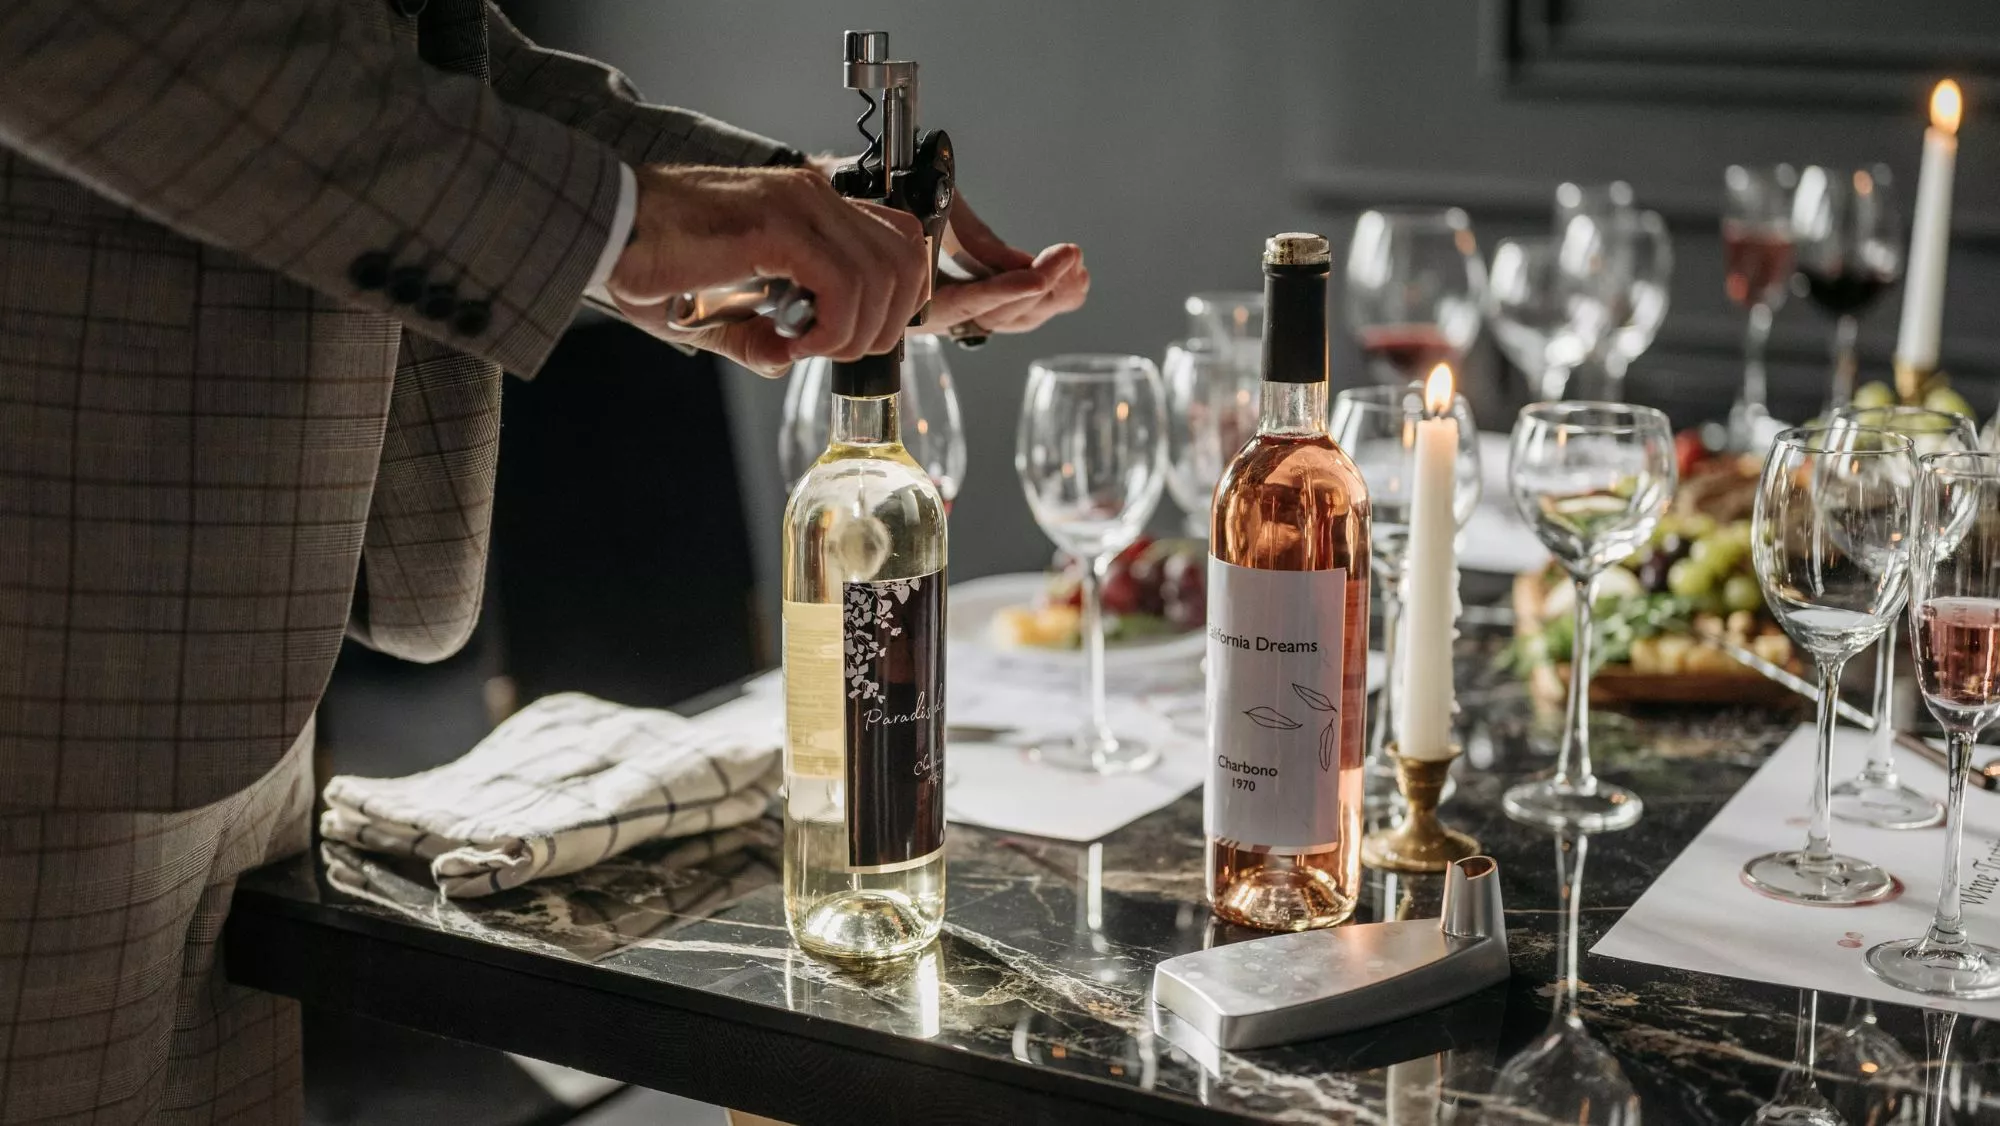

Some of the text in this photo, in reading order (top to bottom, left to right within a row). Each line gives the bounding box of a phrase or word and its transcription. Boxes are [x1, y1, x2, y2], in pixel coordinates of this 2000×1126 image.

[1256, 636, 1318, 653] Dreams
[1217, 754, 1278, 777] Charbono
[1231, 777, 1256, 792] 1970
